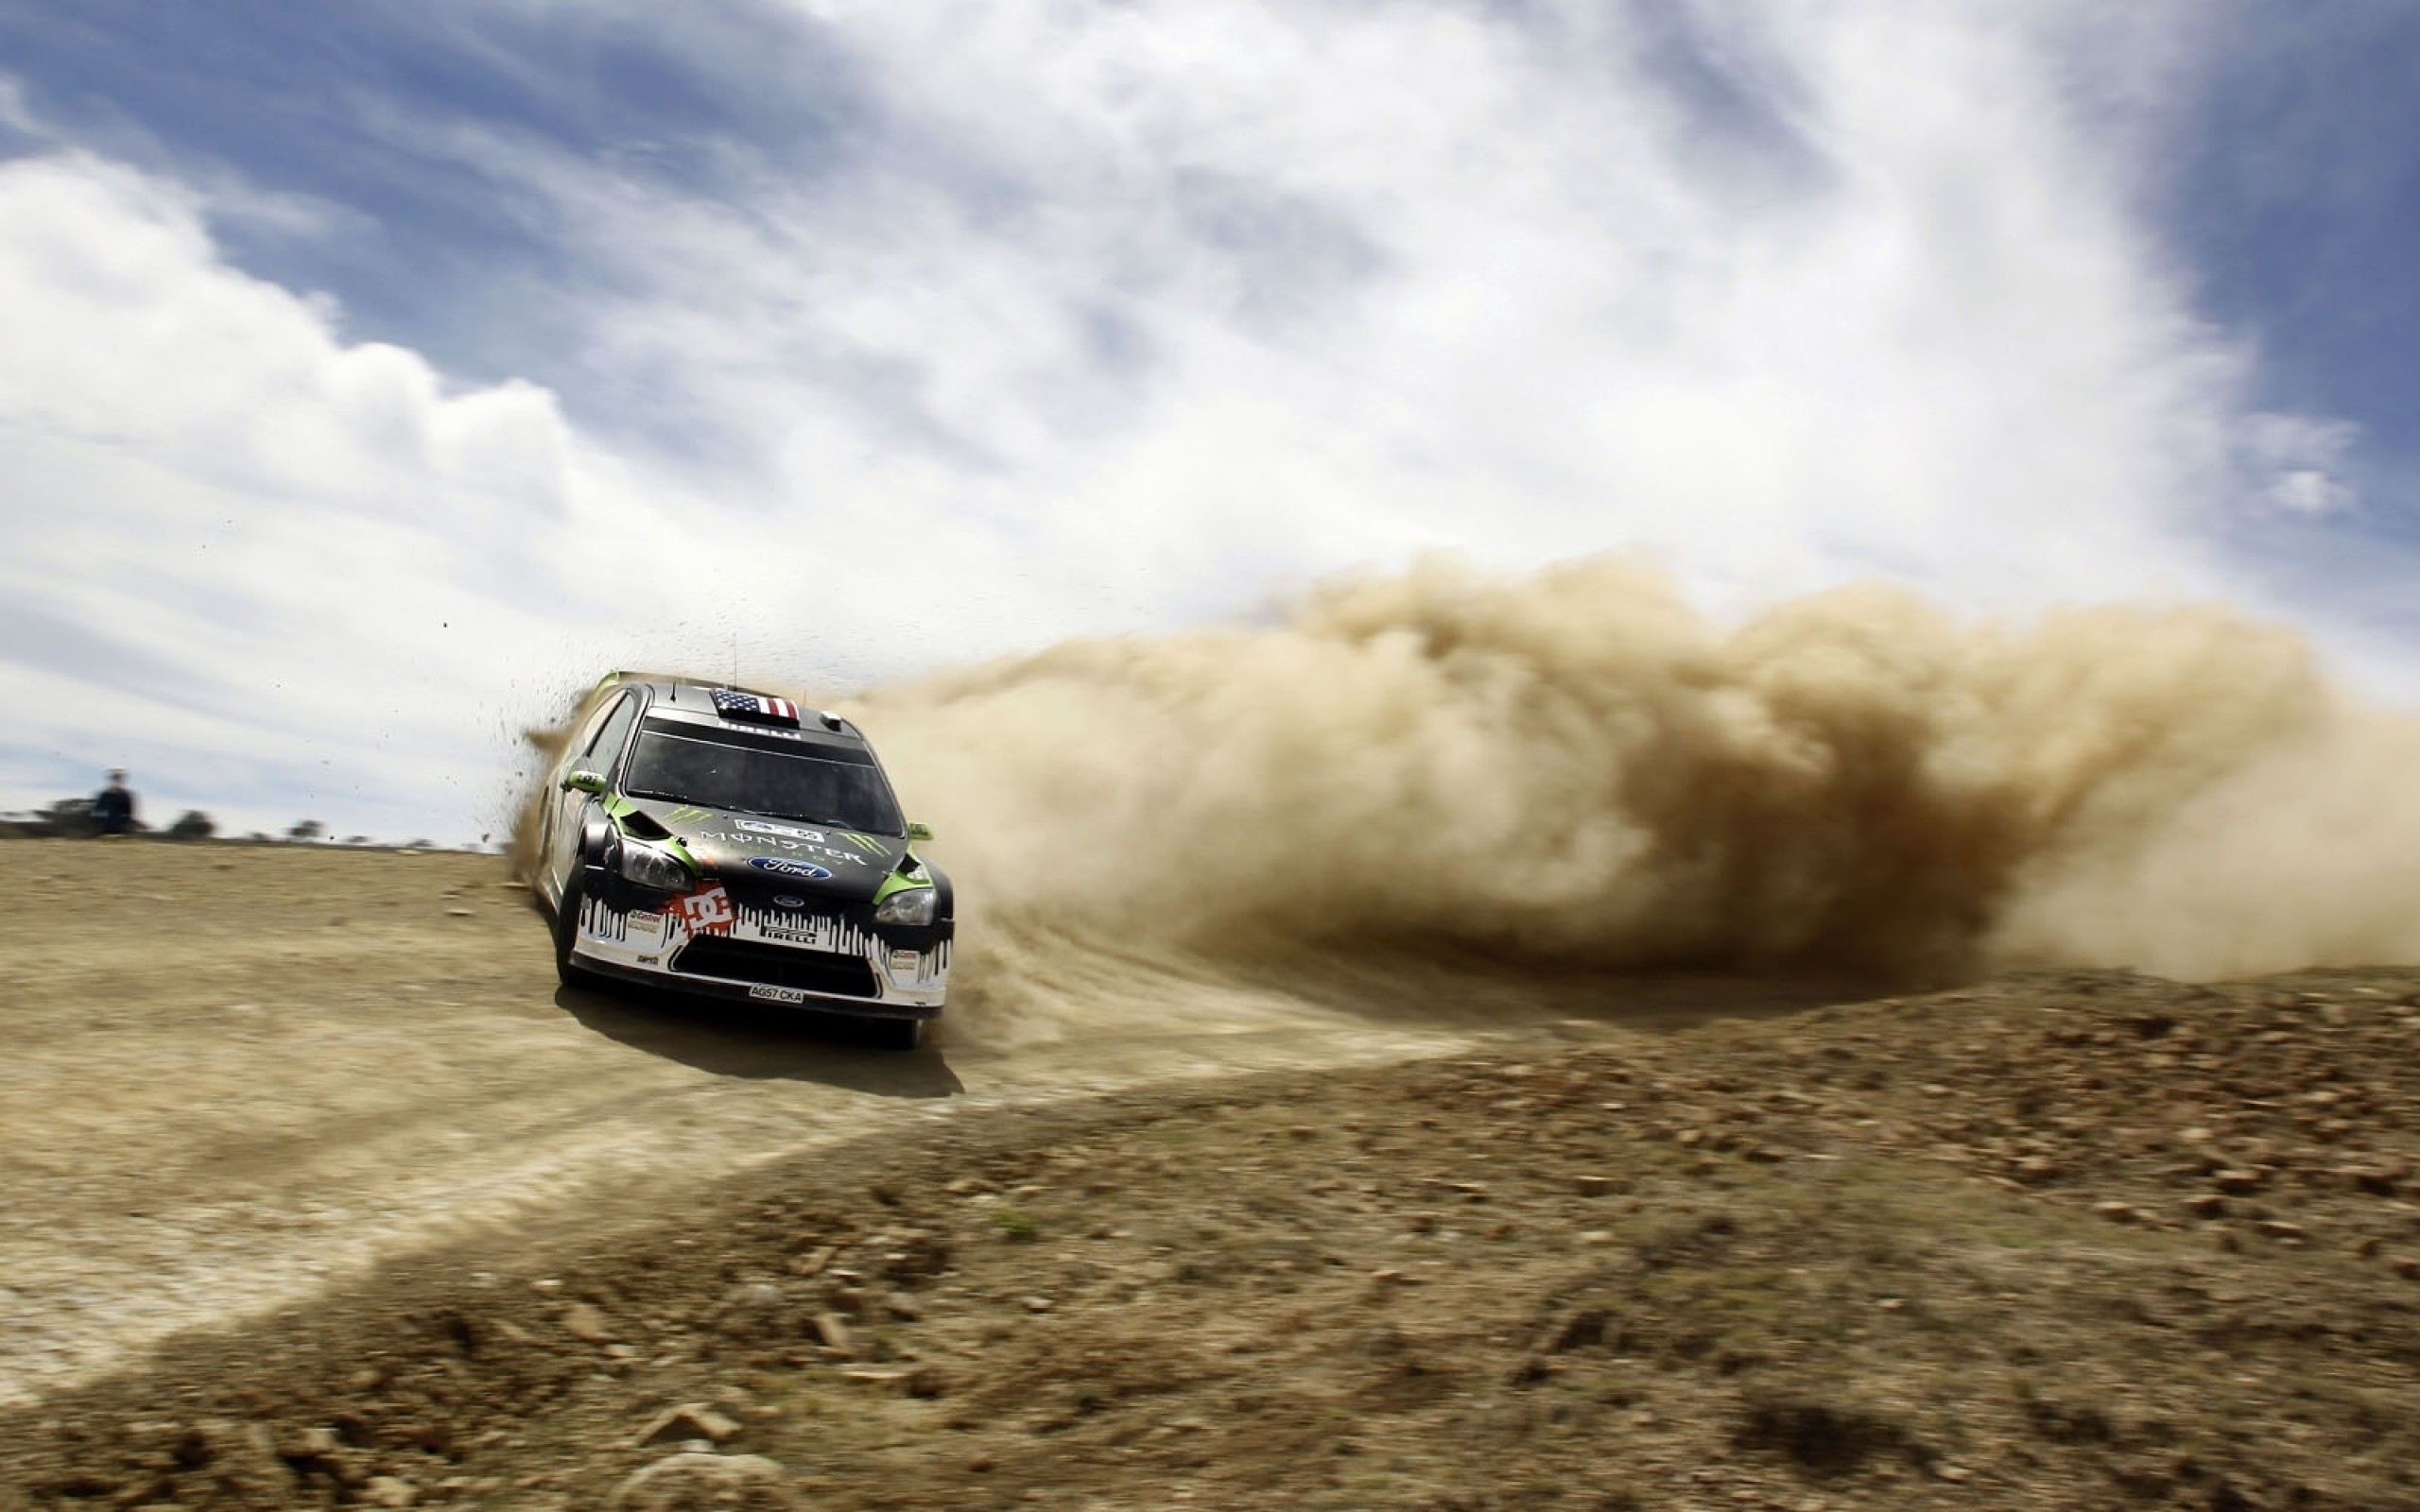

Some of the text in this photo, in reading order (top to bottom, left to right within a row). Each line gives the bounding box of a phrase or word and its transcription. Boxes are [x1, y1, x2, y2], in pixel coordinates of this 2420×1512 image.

[763, 858, 819, 878] Ford
[683, 886, 734, 930] DC
[760, 925, 818, 944] PIRELLI
[752, 987, 802, 1002] AG57 CKA
